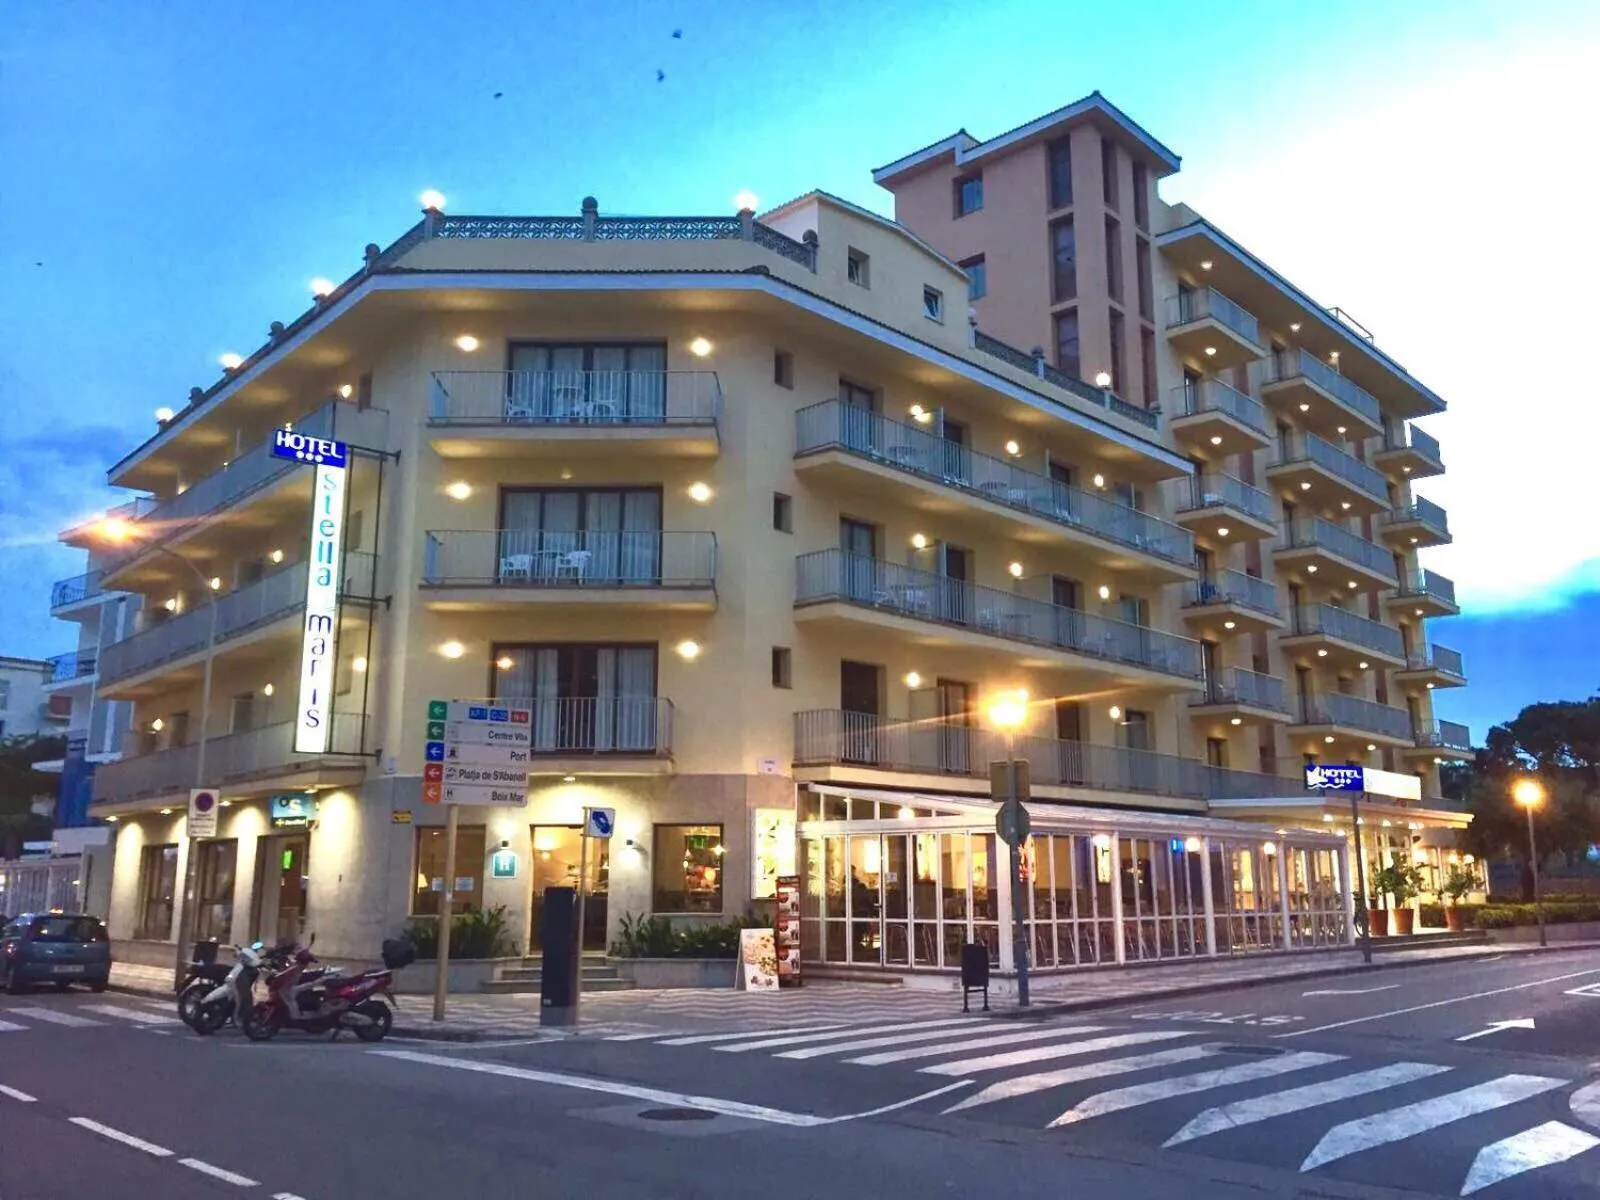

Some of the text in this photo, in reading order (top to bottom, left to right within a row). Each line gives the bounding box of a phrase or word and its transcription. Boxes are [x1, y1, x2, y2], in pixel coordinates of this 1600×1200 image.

[276, 430, 343, 459] HOTEL
[488, 730, 513, 740] Centre
[510, 750, 527, 761] Port
[459, 768, 480, 781] Platja
[481, 770, 492, 780] de
[1320, 768, 1362, 779] HOTEL
